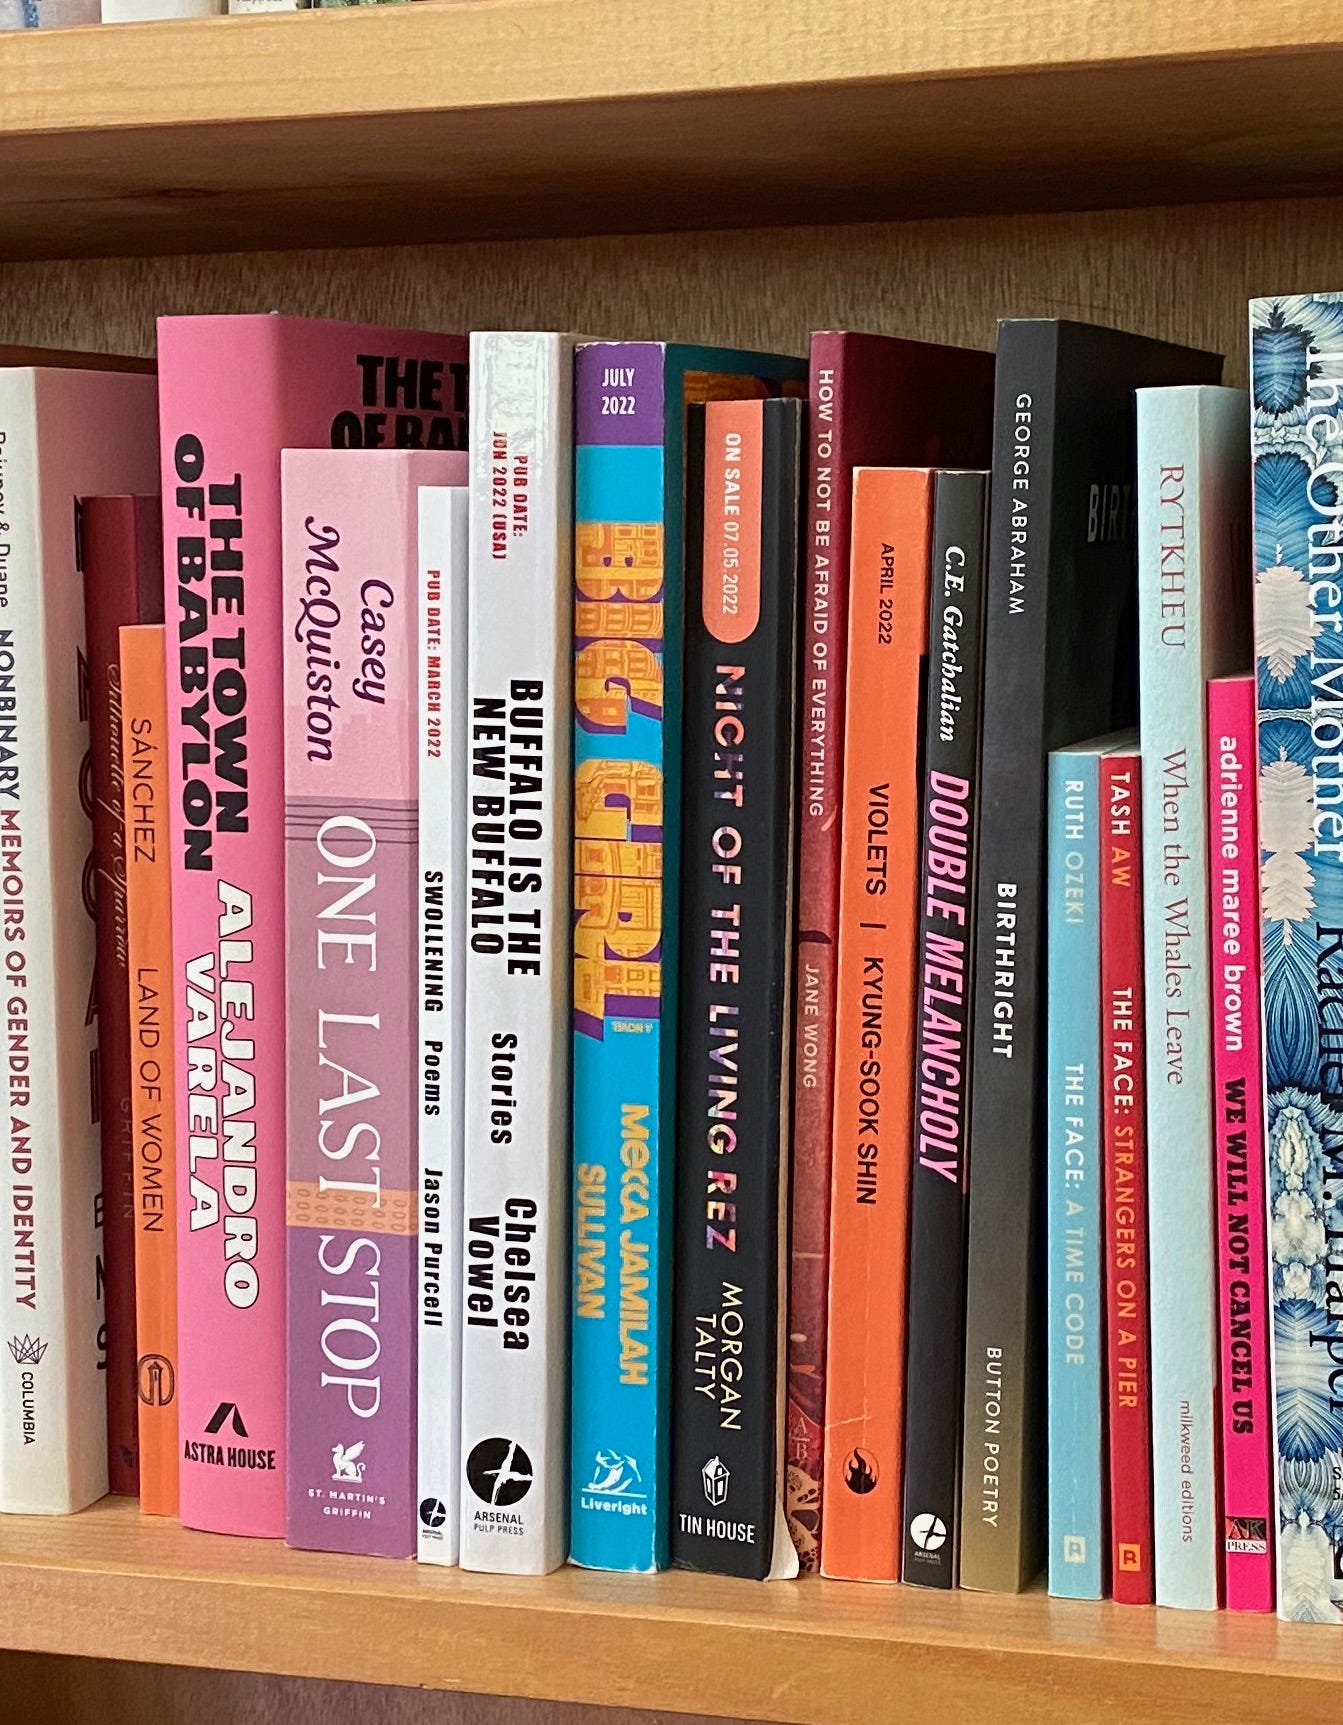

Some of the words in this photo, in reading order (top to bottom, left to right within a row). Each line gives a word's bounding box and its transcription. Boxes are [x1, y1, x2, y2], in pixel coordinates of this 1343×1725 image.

[601, 396, 636, 415] 2022
[602, 368, 634, 387] JULY
[1014, 394, 1031, 490] GEORGE
[879, 543, 894, 594] APRIL
[1008, 499, 1028, 616] ABRAHAM
[293, 515, 342, 762] McQuiston
[359, 578, 395, 706] Casey
[878, 599, 893, 645] 2022
[130, 718, 157, 864] SÁNCHEZ
[1064, 781, 1084, 839] RUTH
[1109, 772, 1130, 836] TASH
[1219, 736, 1239, 859] adrienne
[866, 782, 890, 896] VIOLETS
[1111, 844, 1130, 887] AW
[316, 816, 378, 972] ONE
[1064, 849, 1083, 925] OZEKI
[1220, 871, 1241, 958] maree
[137, 968, 161, 1049] LAND
[1224, 965, 1245, 1053] brown
[140, 1061, 162, 1104] OF
[185, 952, 220, 1232] VARELA
[216, 879, 261, 1311] ALEJANDRO
[316, 1009, 382, 1209] LAST
[424, 1040, 441, 1116] Poems
[491, 1033, 517, 1146] Stories
[141, 1115, 165, 1232] WOMEN
[424, 1169, 442, 1234] Jason
[424, 1244, 444, 1327] Purcell
[467, 1216, 498, 1328] Vowel
[503, 1199, 536, 1352] Chelsea
[318, 1235, 382, 1418] STOP
[693, 1315, 714, 1401] TALTY
[719, 1281, 743, 1432] MORGAN
[21, 1372, 36, 1445] COLUMBIA
[983, 1346, 1002, 1432] BUTTON
[184, 1441, 226, 1467] ASTRA
[228, 1447, 276, 1471] HOUSE
[1179, 1400, 1189, 1473] milkweed
[473, 1512, 524, 1525] ARSENAL
[581, 1496, 647, 1517] Liveright
[982, 1440, 998, 1528] POETRY
[1180, 1481, 1193, 1542] editions
[679, 1513, 704, 1535] TIN
[706, 1516, 756, 1544] HOUSE
